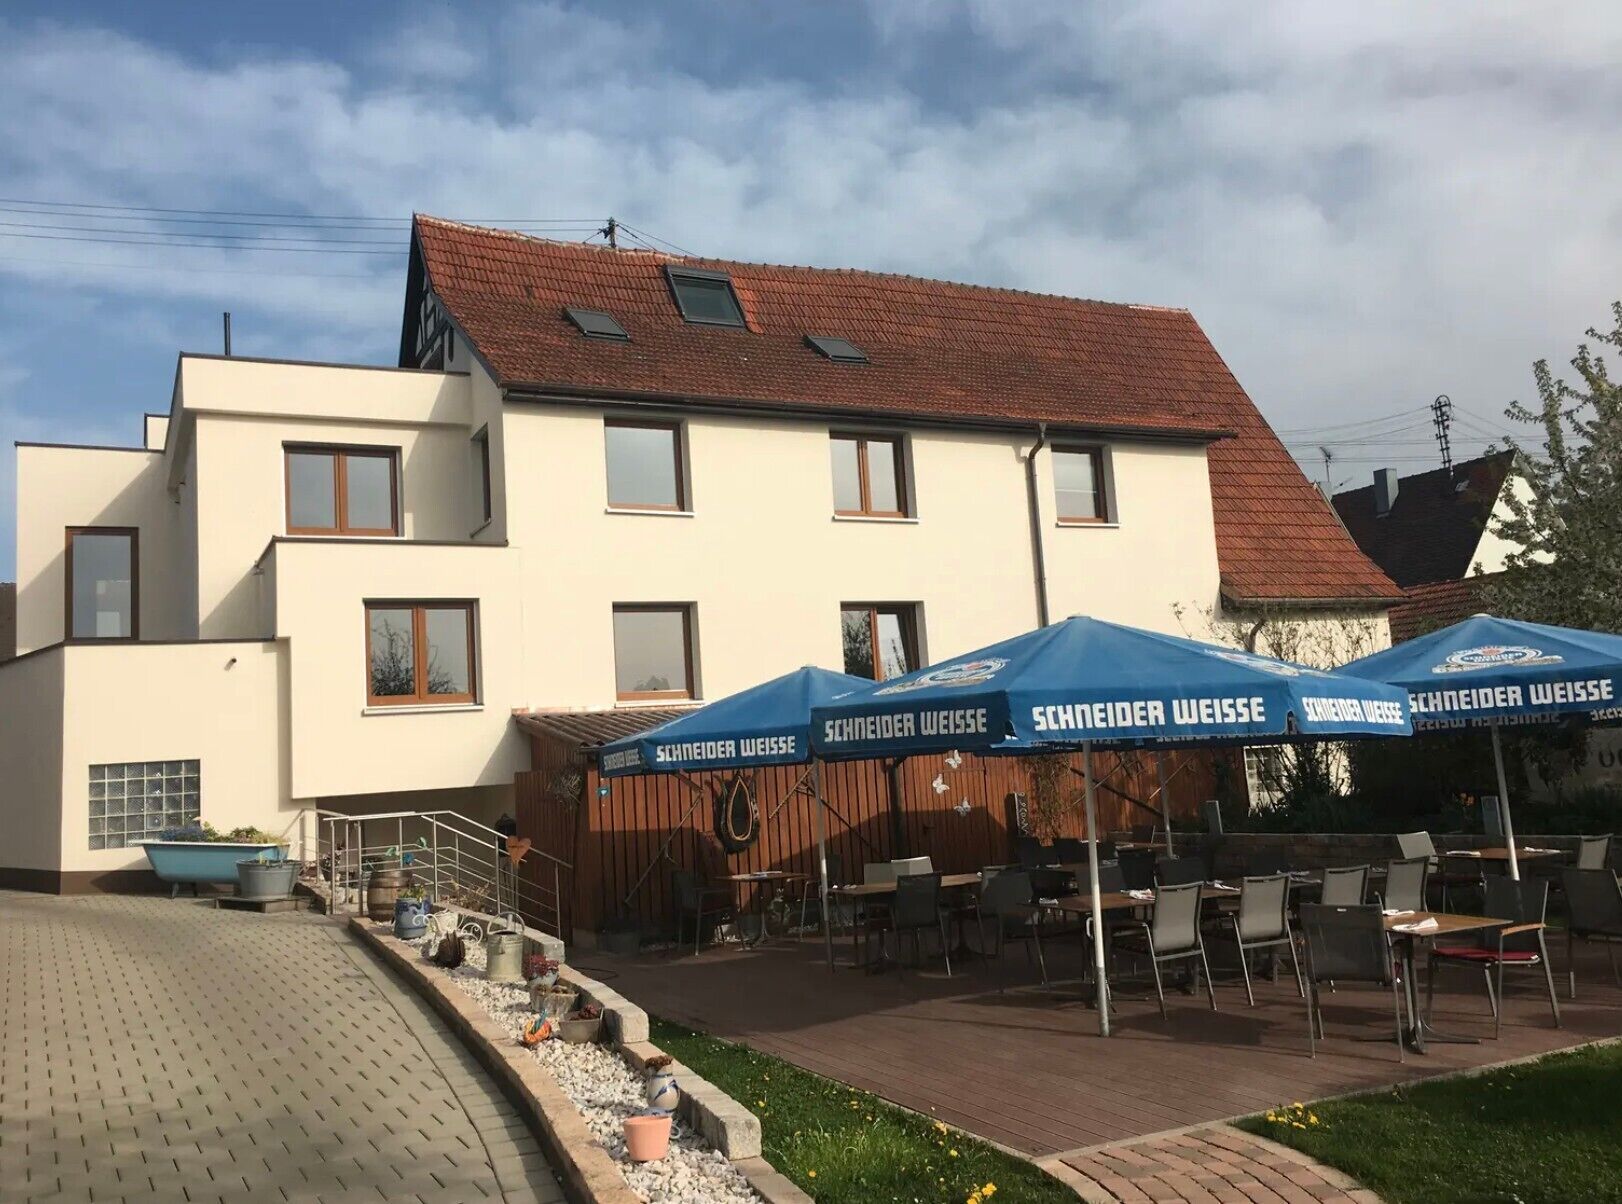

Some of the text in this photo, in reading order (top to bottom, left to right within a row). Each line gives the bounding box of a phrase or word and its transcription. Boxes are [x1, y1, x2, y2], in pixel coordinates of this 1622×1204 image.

[1302, 697, 1405, 725] SCHNEIDER WEISSE
[1409, 679, 1614, 713] SCHNEIDER WEISSE
[824, 708, 988, 743] SCHNEIDER WEISSE
[1032, 697, 1266, 731] SCHNEIDER WEISSE
[656, 736, 796, 763] SCHNEIDER WEISSE
